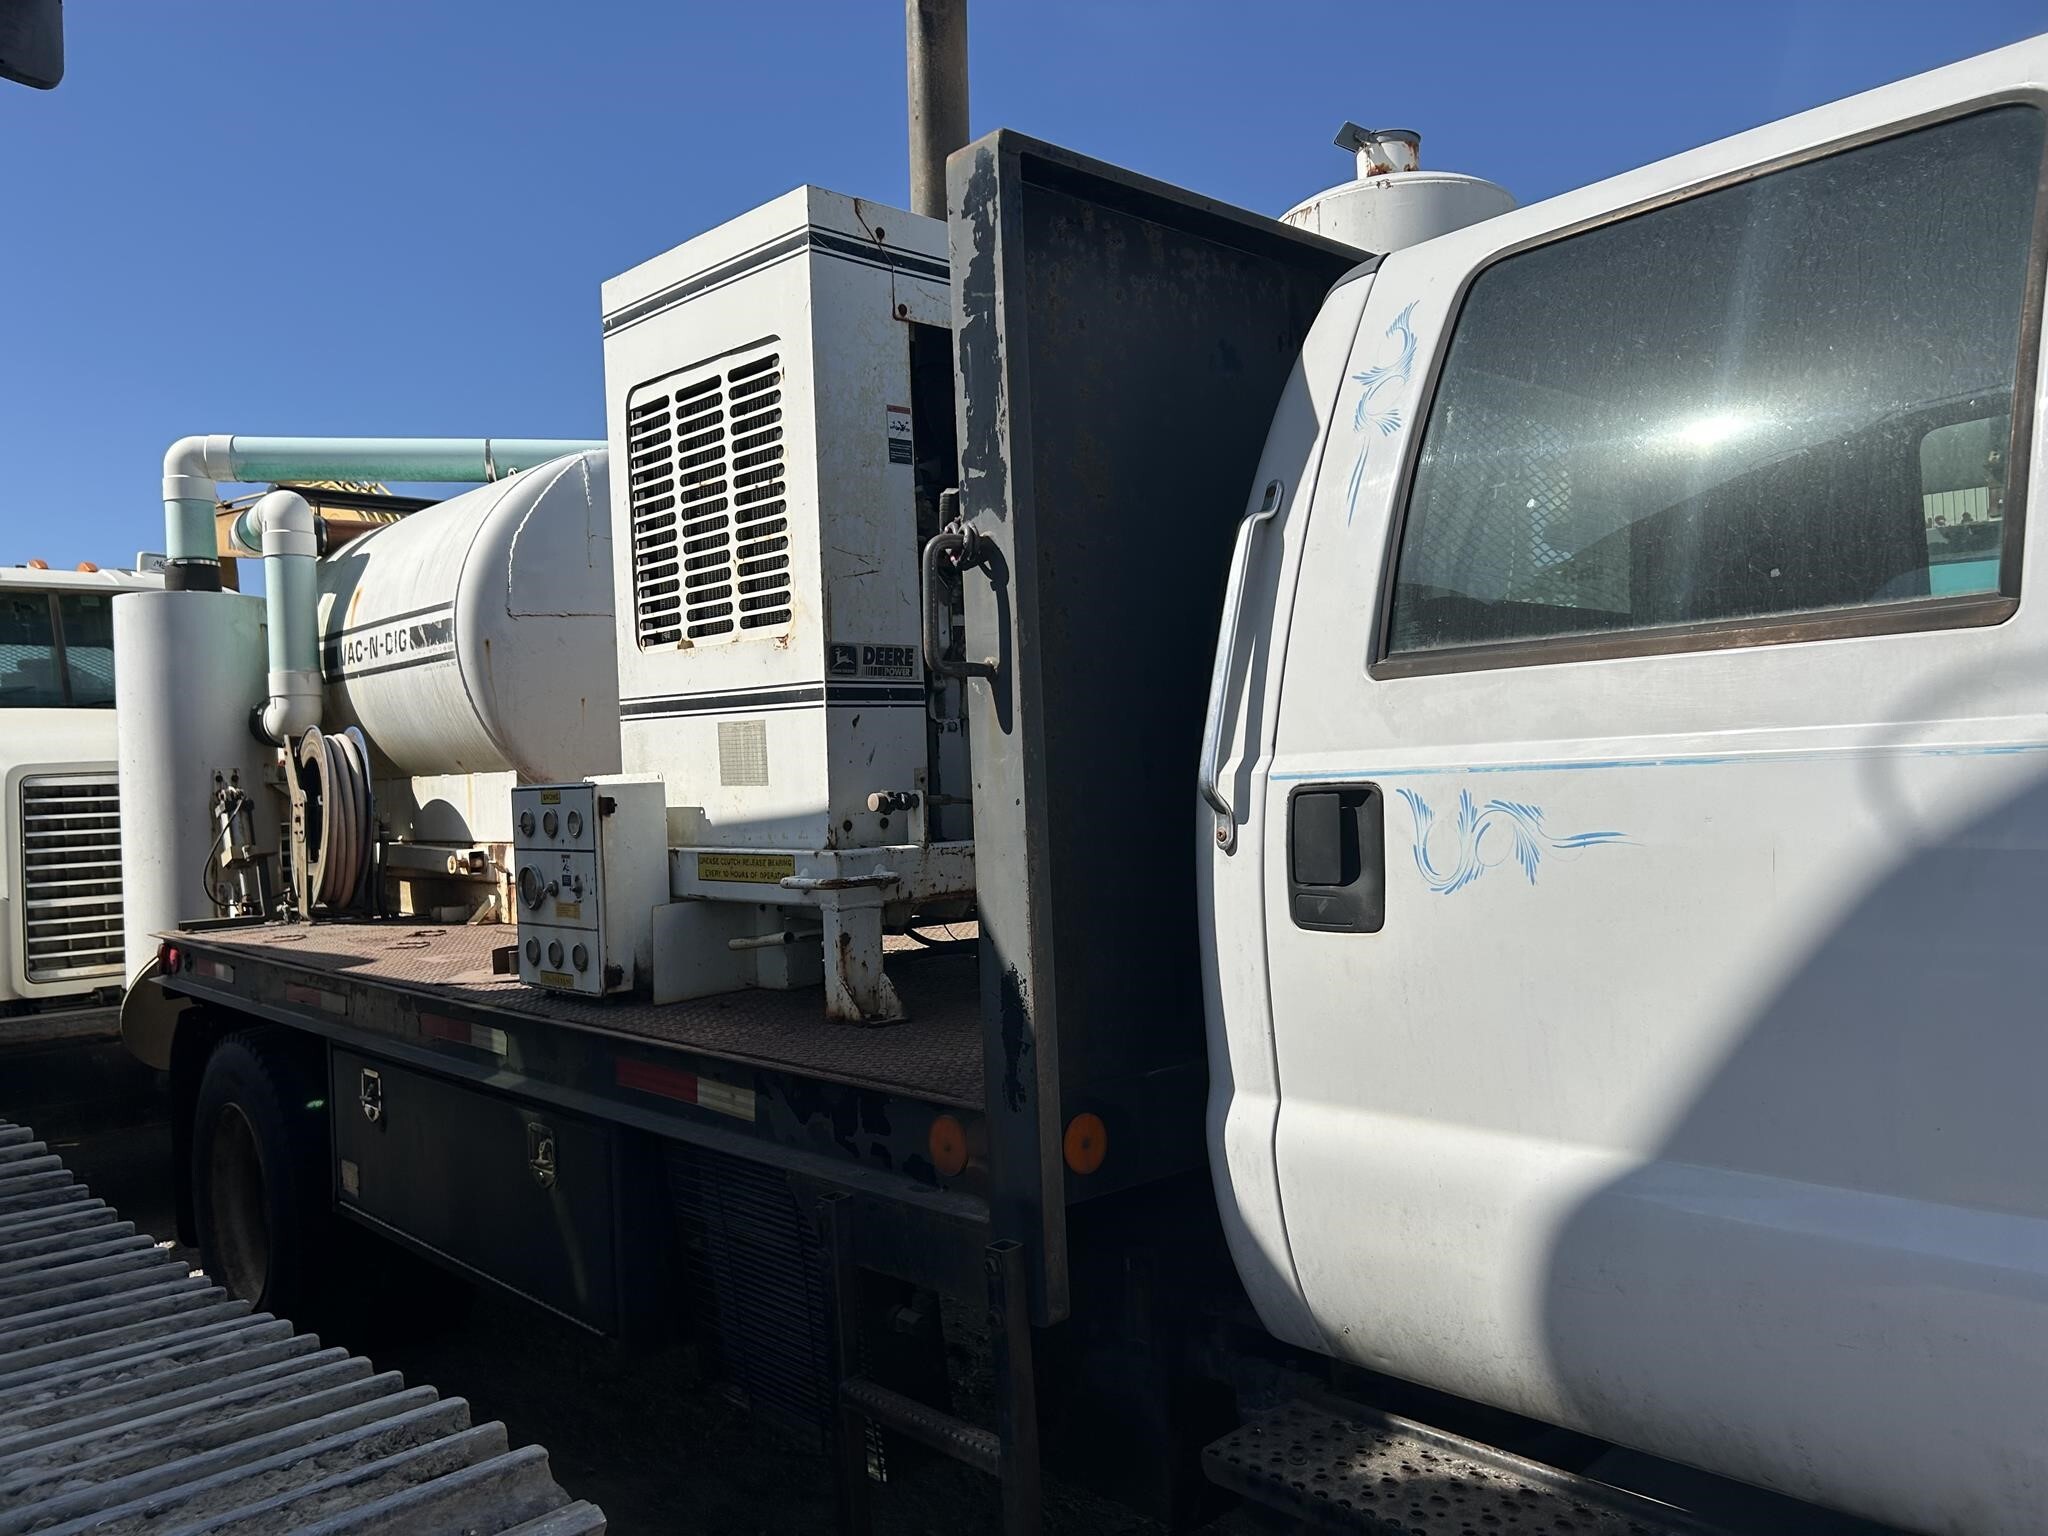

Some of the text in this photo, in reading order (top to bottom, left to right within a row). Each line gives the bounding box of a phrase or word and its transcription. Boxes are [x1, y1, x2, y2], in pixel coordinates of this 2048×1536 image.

[340, 629, 407, 666] VAC-N-DIG
[863, 646, 914, 666] DEERE
[884, 667, 910, 676] POWER
